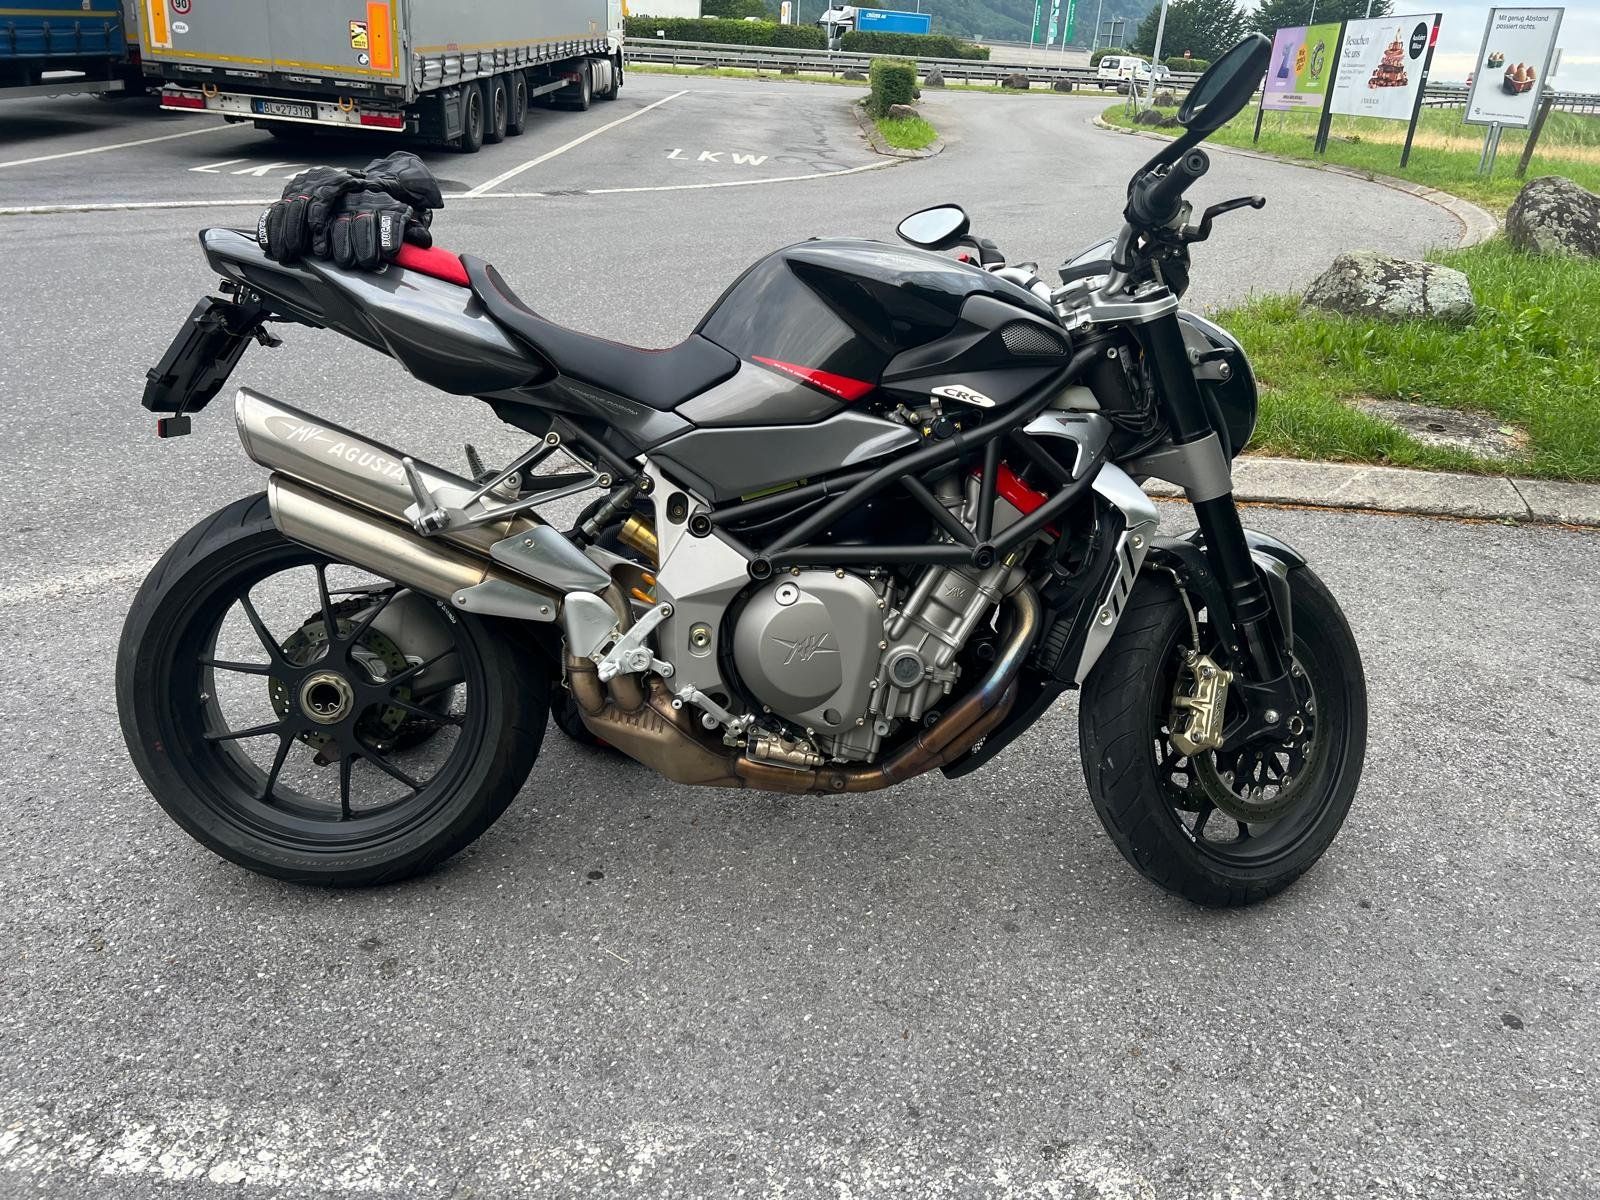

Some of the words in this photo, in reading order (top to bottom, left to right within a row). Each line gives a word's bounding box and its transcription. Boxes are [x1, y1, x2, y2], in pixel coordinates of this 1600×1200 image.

[666, 148, 769, 166] LKW
[943, 388, 983, 404] CRC
[327, 442, 405, 480] AGUSTA
